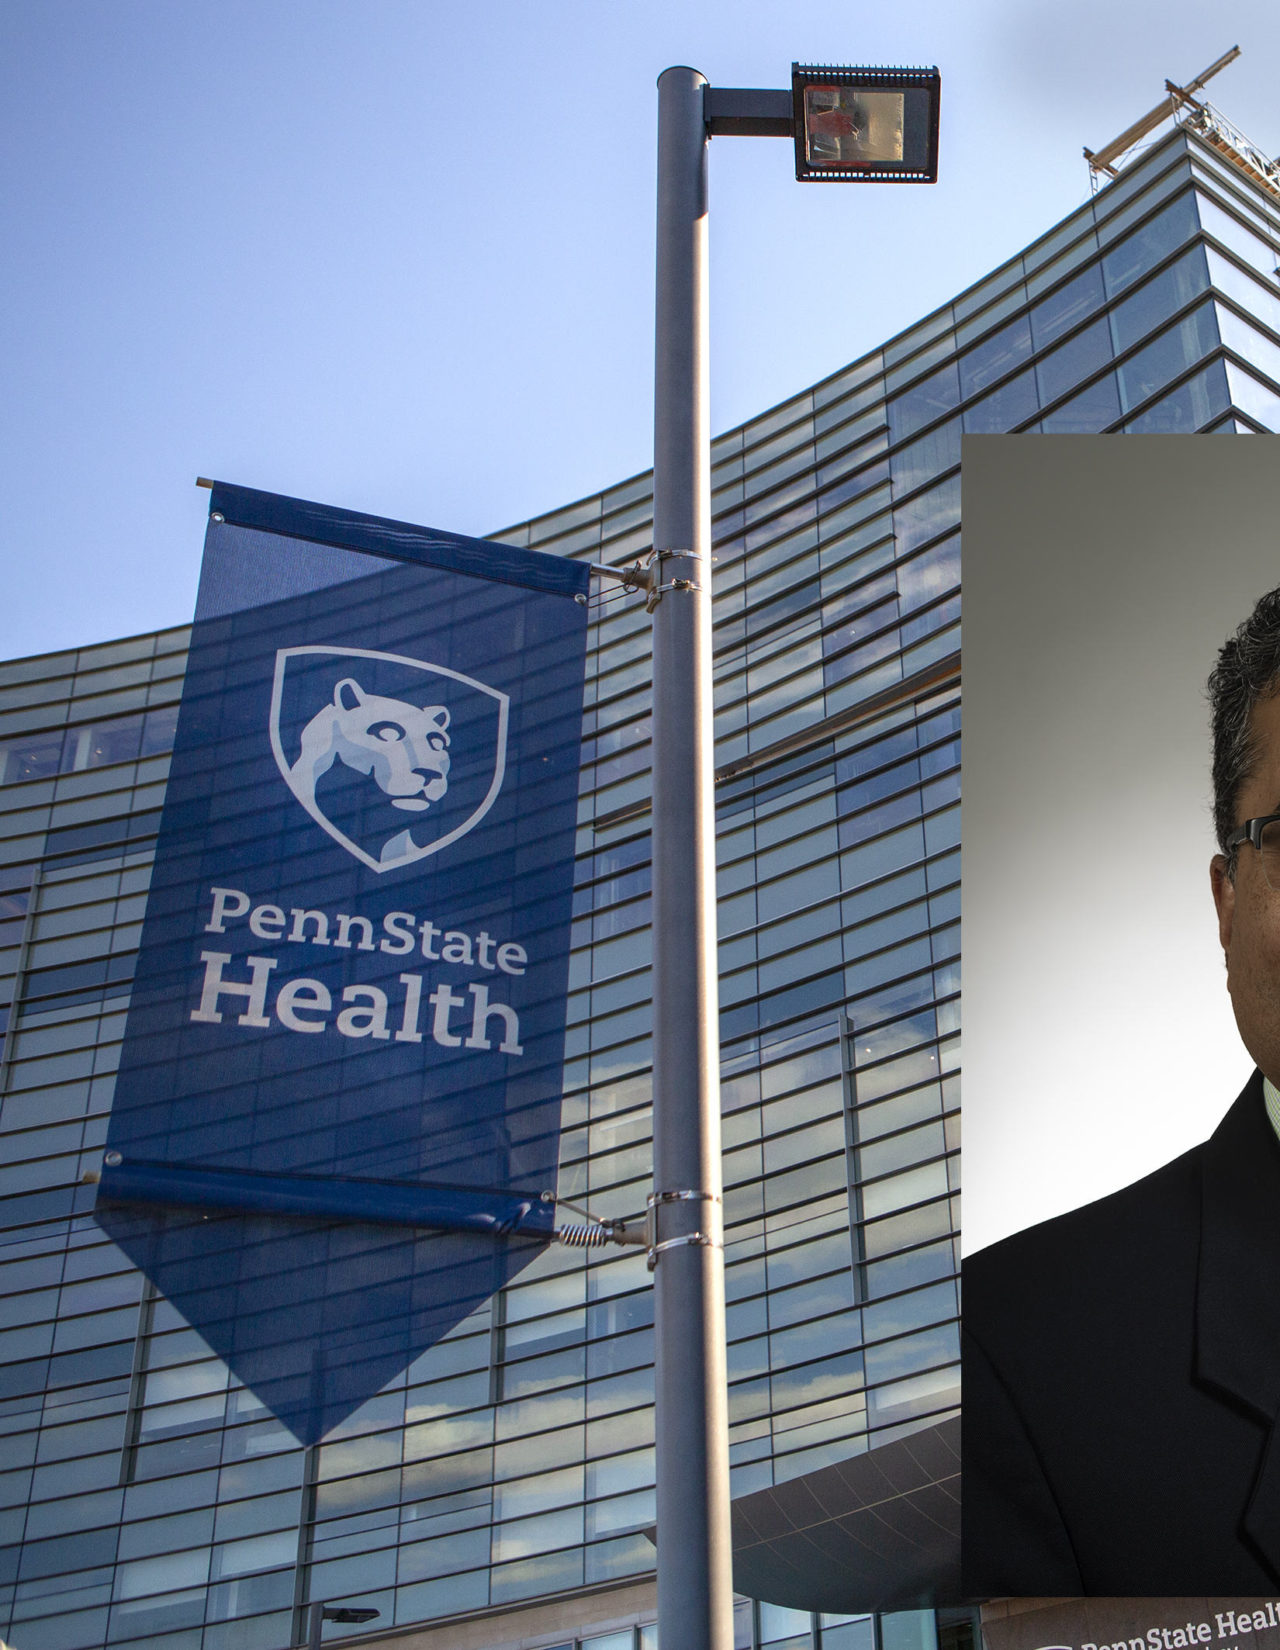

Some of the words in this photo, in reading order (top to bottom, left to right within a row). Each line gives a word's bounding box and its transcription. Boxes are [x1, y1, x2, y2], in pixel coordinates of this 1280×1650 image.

[204, 886, 528, 975] PennState
[190, 951, 524, 1056] Health
[1081, 1622, 1212, 1650] nnState
